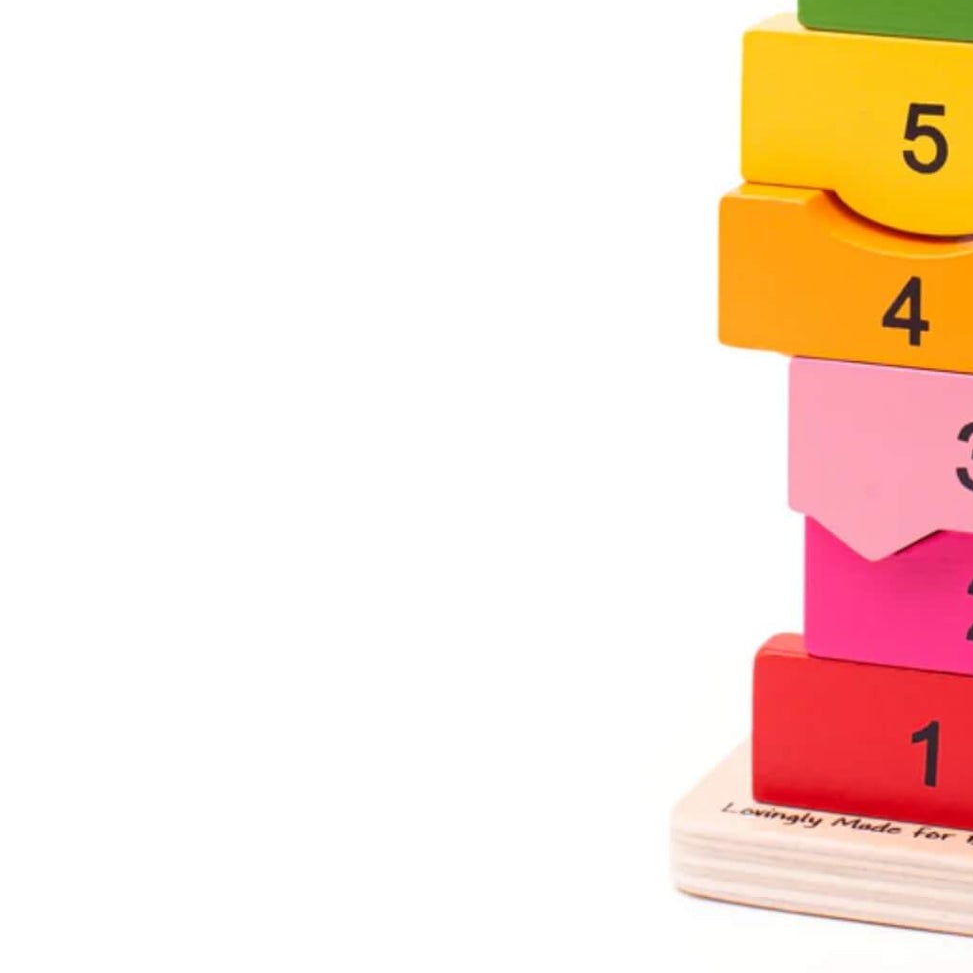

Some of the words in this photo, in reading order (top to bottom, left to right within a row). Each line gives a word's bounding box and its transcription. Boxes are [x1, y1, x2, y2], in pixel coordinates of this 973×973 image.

[902, 103, 948, 174] 5
[881, 277, 930, 346] 4
[910, 722, 941, 787] 1
[721, 801, 823, 828] Lovingly
[831, 816, 902, 835] Made
